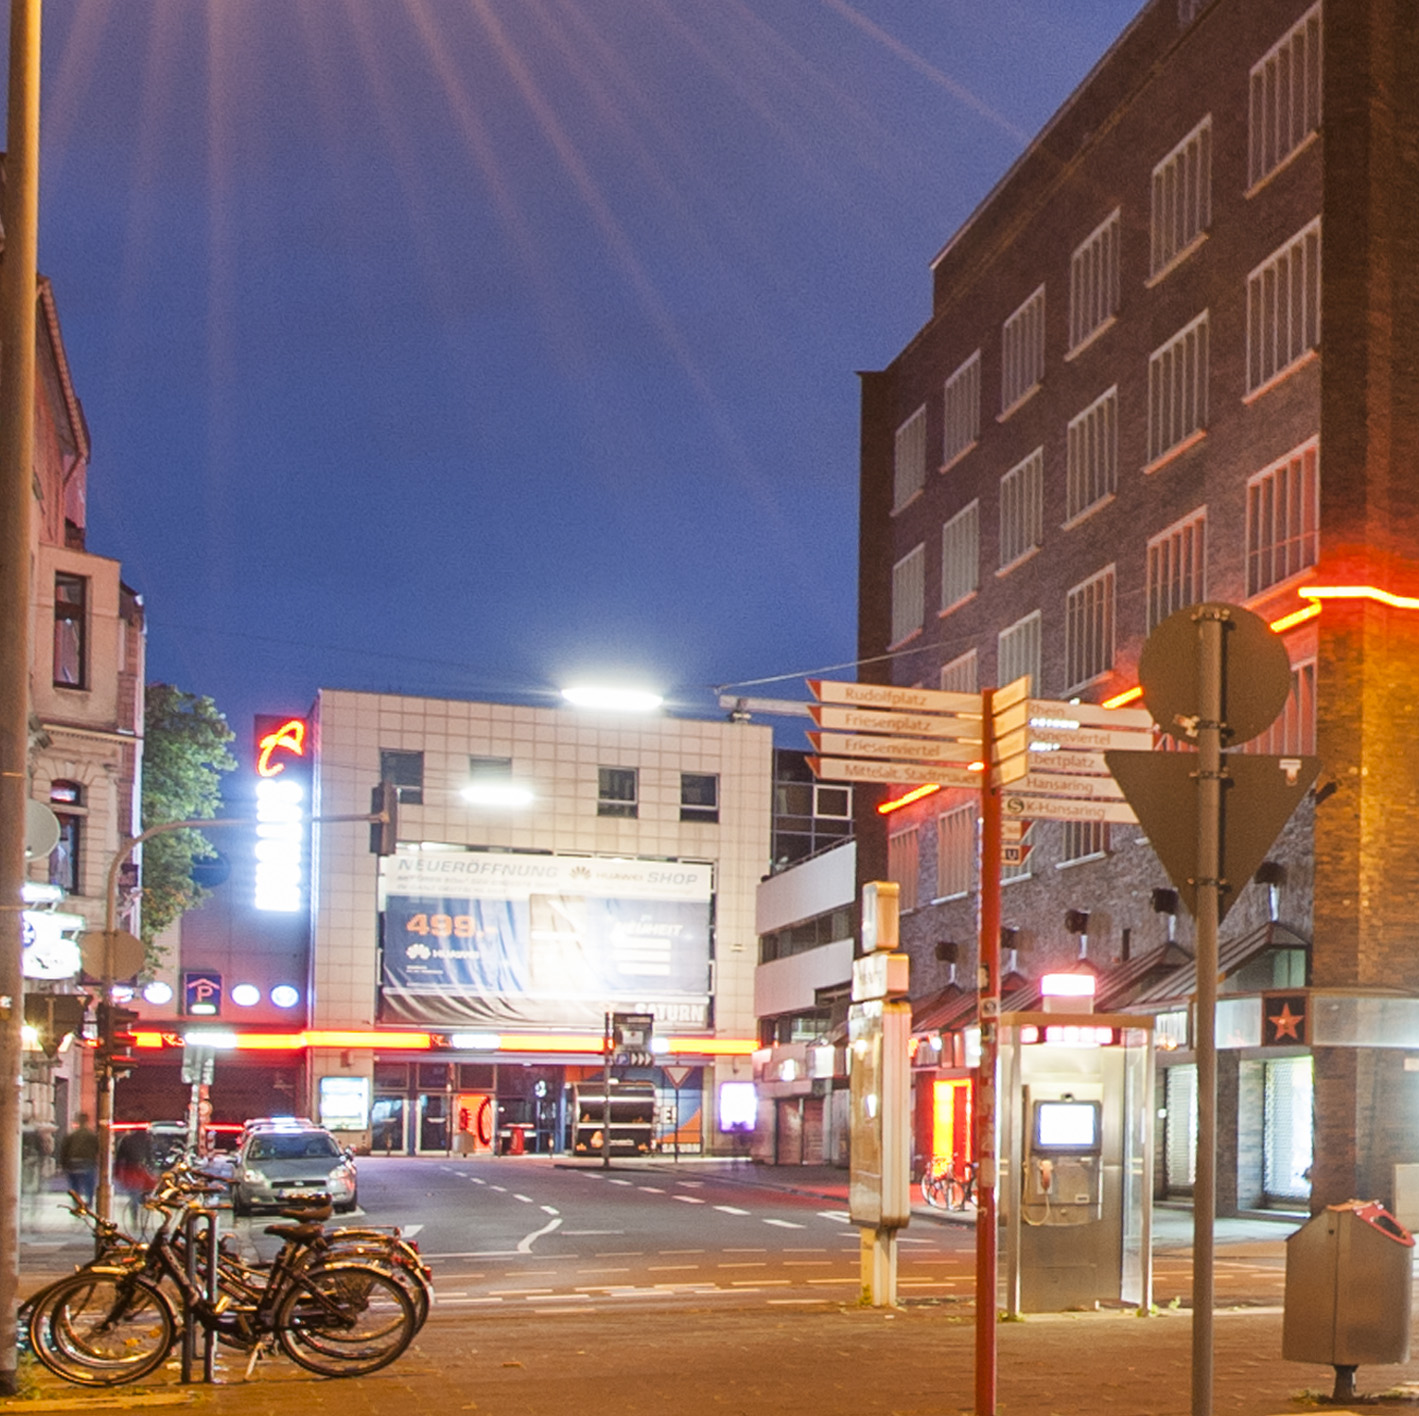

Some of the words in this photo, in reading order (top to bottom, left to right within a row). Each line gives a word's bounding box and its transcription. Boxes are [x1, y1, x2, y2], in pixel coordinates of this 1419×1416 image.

[844, 687, 927, 706] Rudolfplatz
[844, 714, 932, 732] Friesenplatz
[844, 739, 940, 757] Friesenviertel
[903, 767, 978, 784] Stadtmauer
[1026, 777, 1094, 794] Hansaring
[1026, 801, 1106, 820] K-Hansaring
[398, 857, 558, 879] NEUERÖFFNUNG
[647, 870, 699, 886] SHOP
[197, 986, 213, 1003] P
[661, 1143, 701, 1153] SAURN
